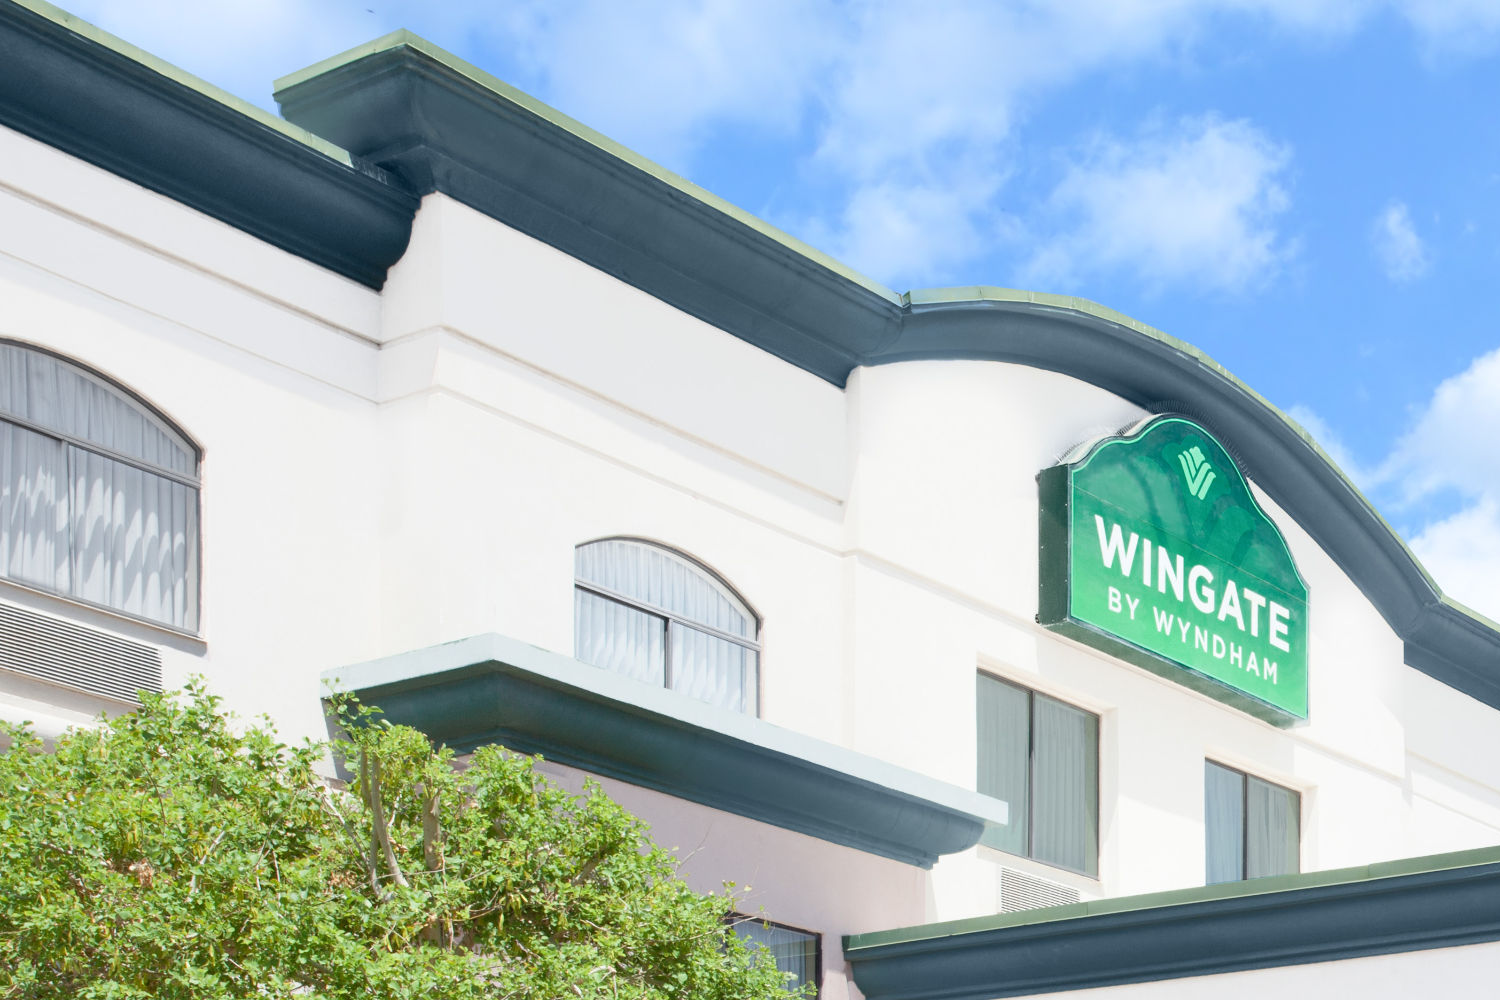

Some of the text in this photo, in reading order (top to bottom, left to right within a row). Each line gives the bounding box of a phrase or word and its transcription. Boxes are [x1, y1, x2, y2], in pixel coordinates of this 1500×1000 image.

[1095, 514, 1290, 653] WINGATE
[1108, 585, 1278, 685] BY WYNDHAM
